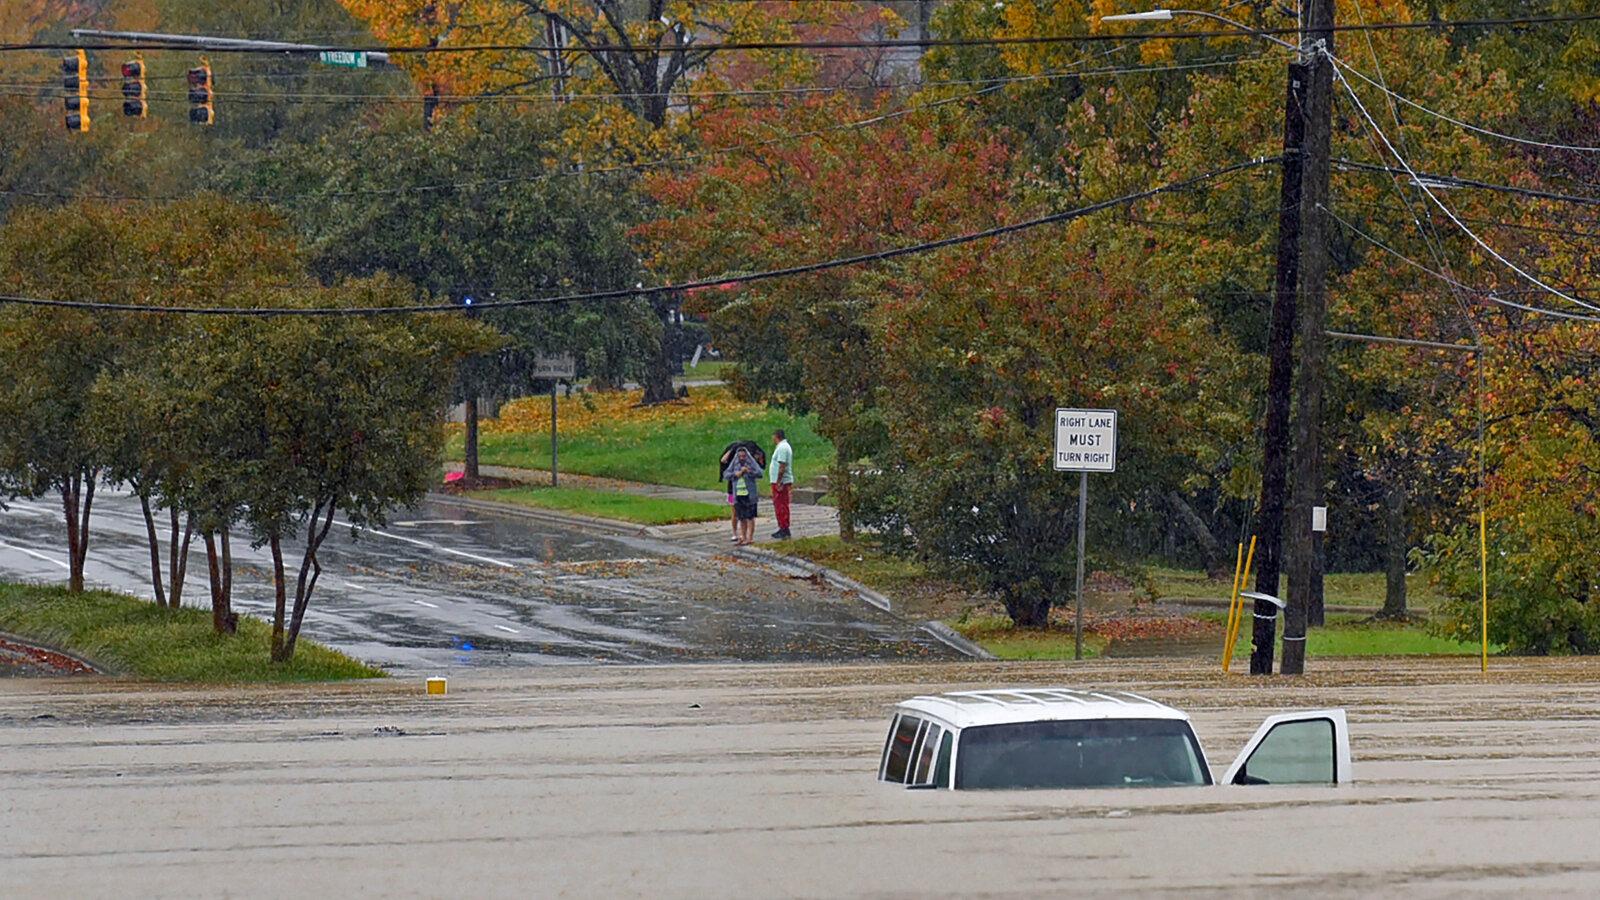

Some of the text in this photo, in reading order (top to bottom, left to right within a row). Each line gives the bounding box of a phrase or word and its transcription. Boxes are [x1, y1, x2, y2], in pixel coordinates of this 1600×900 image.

[1060, 417, 1112, 428] RIGHT LANE
[1070, 434, 1101, 446] MUST
[1059, 452, 1110, 463] TURN RIGHT
